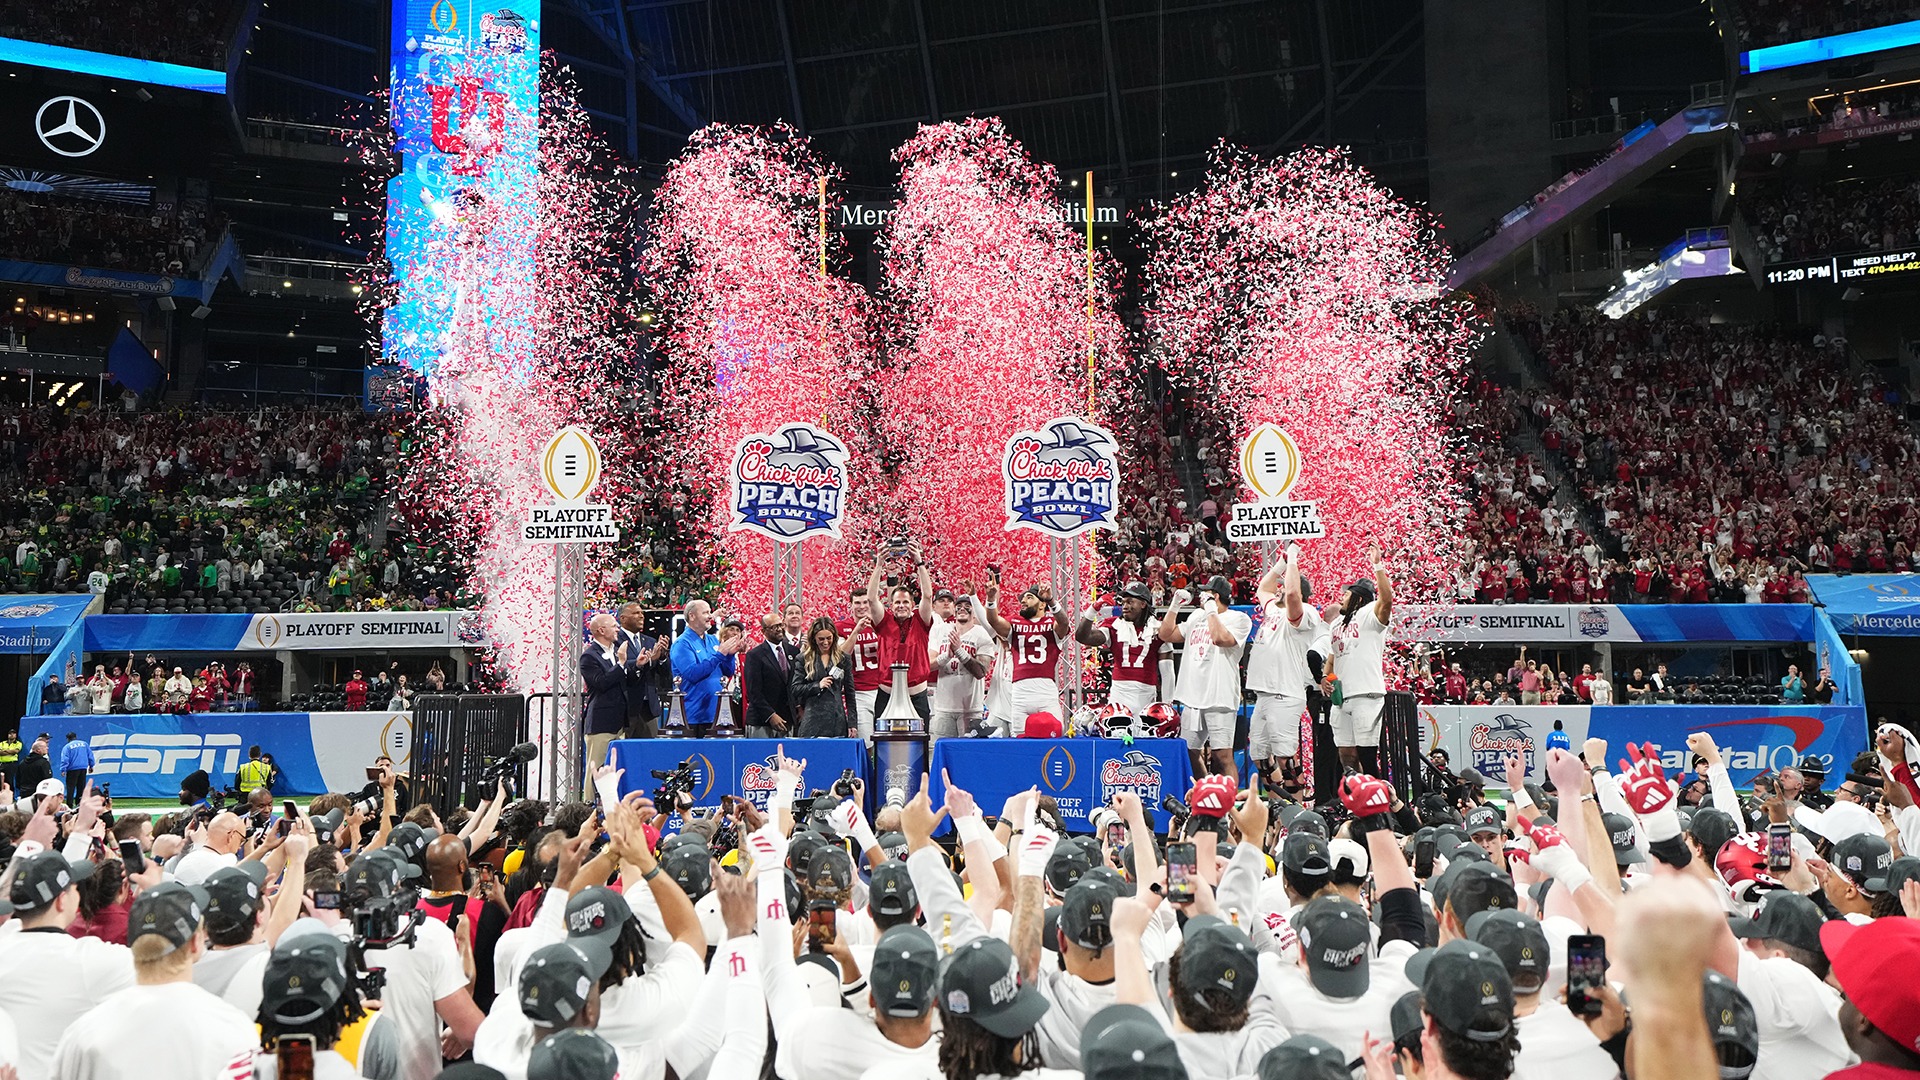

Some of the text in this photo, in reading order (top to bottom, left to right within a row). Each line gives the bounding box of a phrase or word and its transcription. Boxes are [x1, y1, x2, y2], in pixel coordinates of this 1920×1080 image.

[1843, 129, 1853, 139] 31
[1856, 123, 1897, 136] WILLIAM
[157, 203, 172, 212] 247
[1853, 252, 1916, 267] NEED HELP?
[1768, 265, 1831, 283] 11:20 PM
[1840, 267, 1866, 278] TEXT
[741, 445, 839, 488] Chick-fil-A
[1012, 444, 1110, 482] Chick-fil-A
[739, 483, 838, 515] PEACH
[1013, 481, 1111, 508] PEACH
[533, 508, 607, 523] PLAYOFF
[757, 508, 816, 520] BOWL
[1032, 503, 1092, 515] BOWL
[1237, 505, 1311, 521] PLAYOFF
[525, 525, 615, 539] SEMIFINAL
[1230, 521, 1321, 537] SEMIFINAL
[92, 577, 103, 587] 24
[285, 621, 444, 637] PLAYOFF SEMIFINAL
[1011, 622, 1053, 634] INDIANA
[1480, 615, 1565, 629] SEMIFINAL
[854, 642, 879, 672] 15
[1017, 635, 1048, 666] 13
[1121, 640, 1150, 668] 17
[88, 733, 243, 775] ESPN
[1104, 765, 1159, 786] Chick-fil-A
